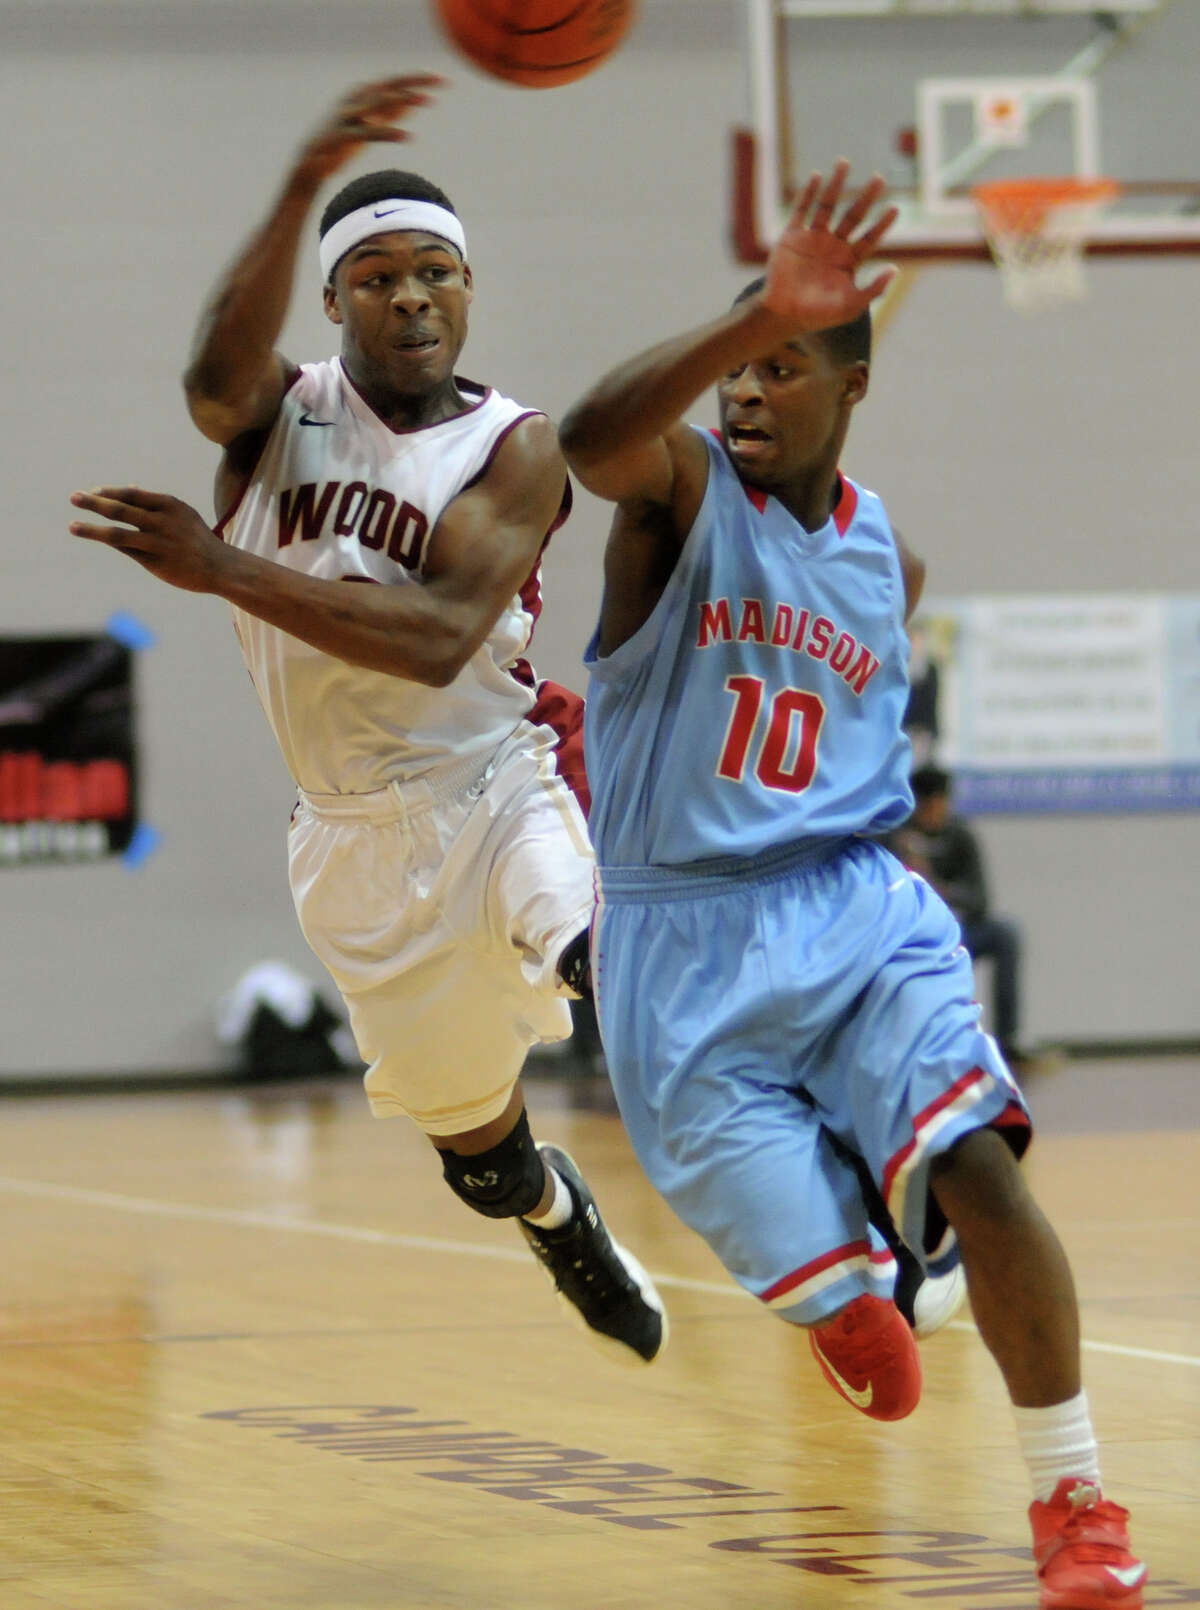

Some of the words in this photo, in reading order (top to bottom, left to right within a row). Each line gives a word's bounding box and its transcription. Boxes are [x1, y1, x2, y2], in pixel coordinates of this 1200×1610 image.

[277, 480, 429, 571] WOOD
[696, 597, 881, 696] MADISON
[715, 674, 827, 795] 10
[198, 1405, 848, 1529] CAMPBELL
